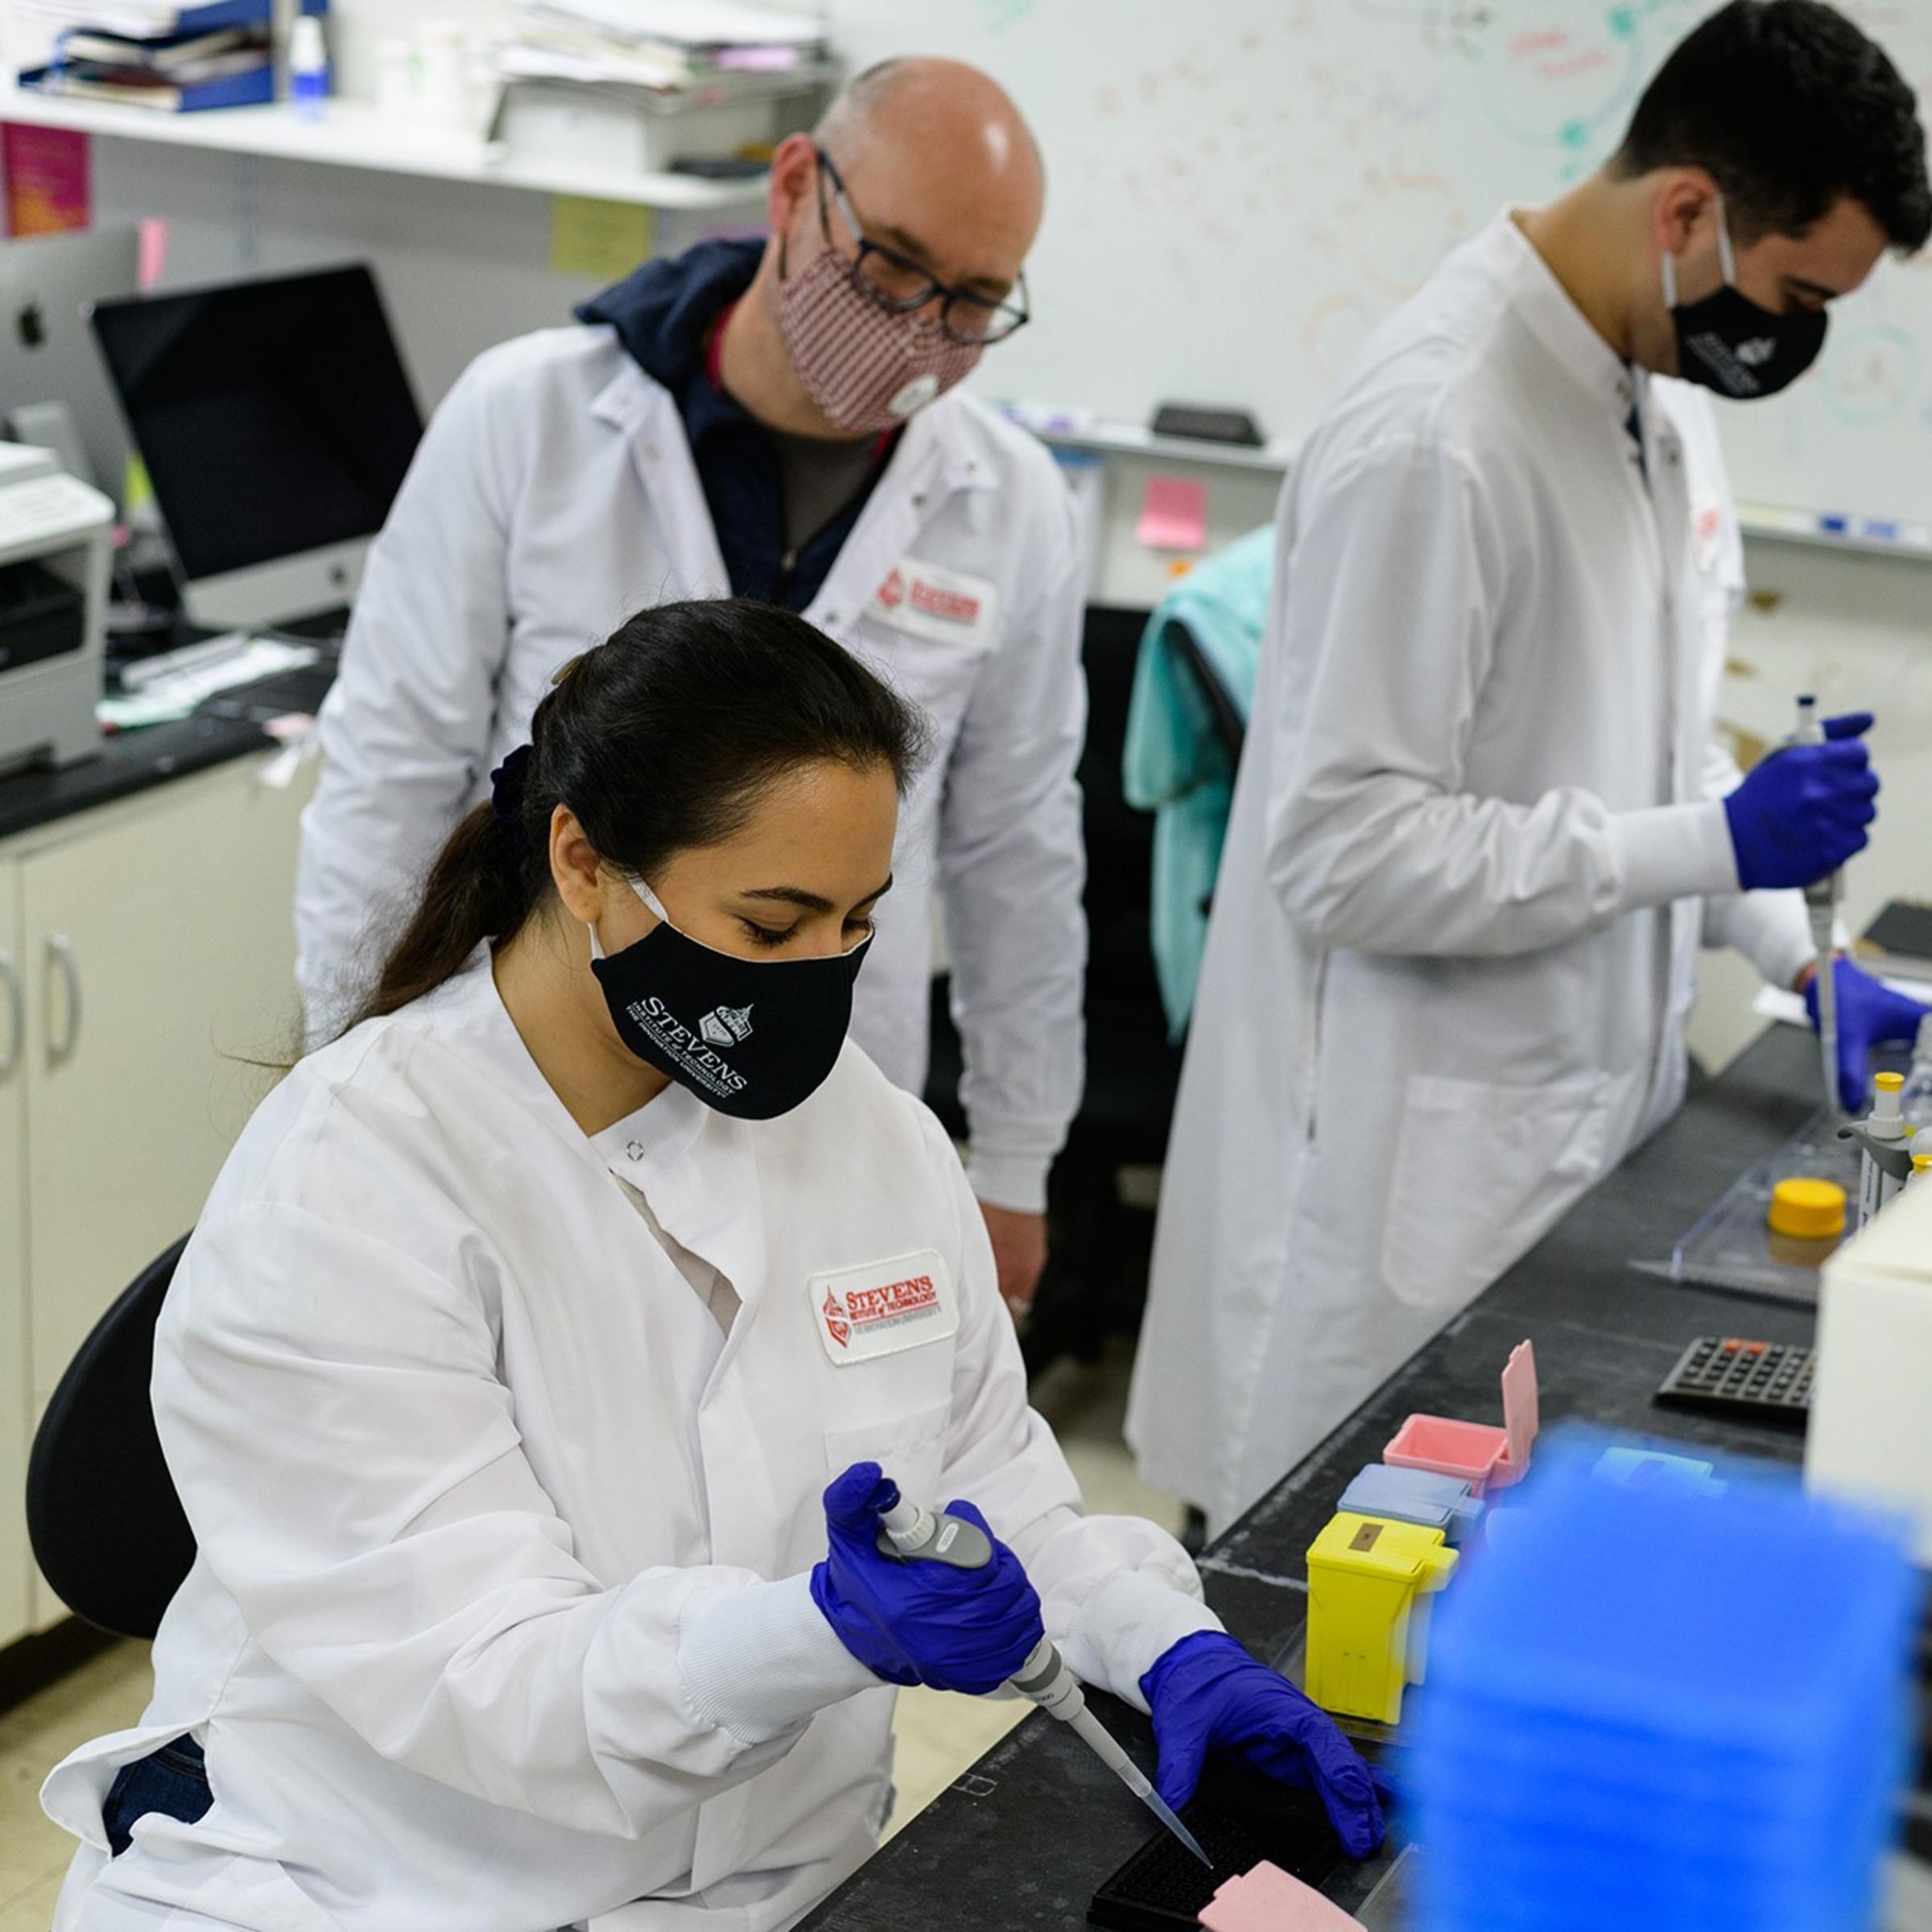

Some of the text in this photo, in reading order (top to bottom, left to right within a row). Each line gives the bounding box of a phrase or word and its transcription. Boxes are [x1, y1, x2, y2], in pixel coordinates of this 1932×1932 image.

[625, 1005, 638, 1022] THE
[641, 997, 747, 1090] STEVENS
[632, 1001, 673, 1044] INSTITUTE
[682, 1051, 735, 1094] TECHNOLOGY
[846, 1275, 933, 1310] STEVENS
